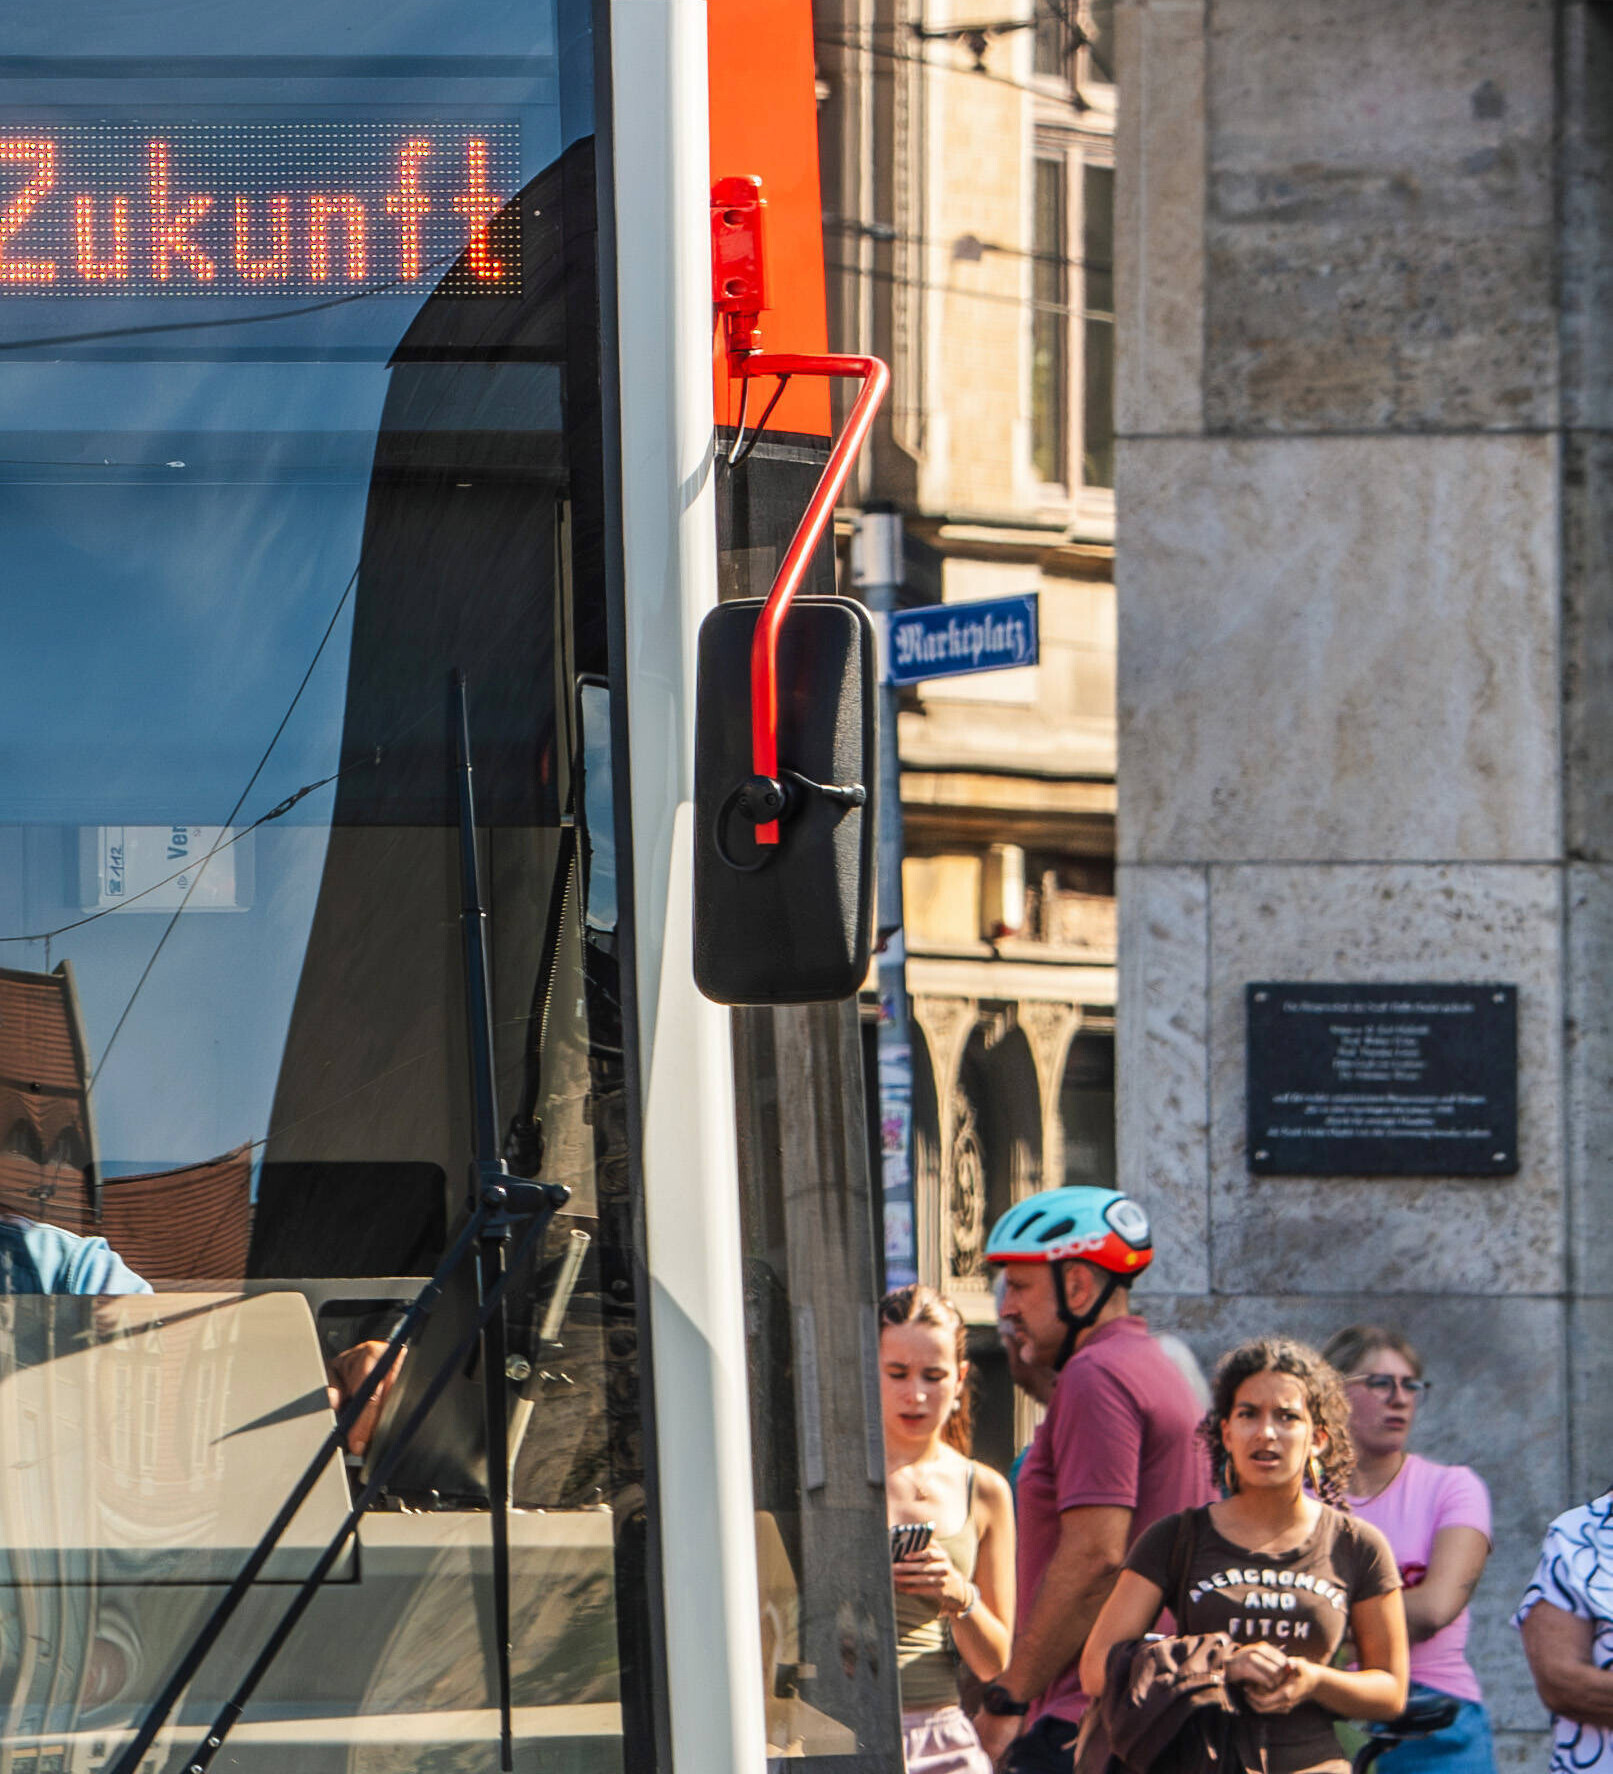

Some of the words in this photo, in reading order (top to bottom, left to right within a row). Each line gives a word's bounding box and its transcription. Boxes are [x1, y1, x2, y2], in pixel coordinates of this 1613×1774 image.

[895, 612, 1026, 667] Marktplatz
[167, 826, 188, 860] Ver
[1188, 1567, 1346, 1610] ABERCROMBIE
[1244, 1590, 1297, 1611] AND
[1228, 1617, 1310, 1640] FITCH
